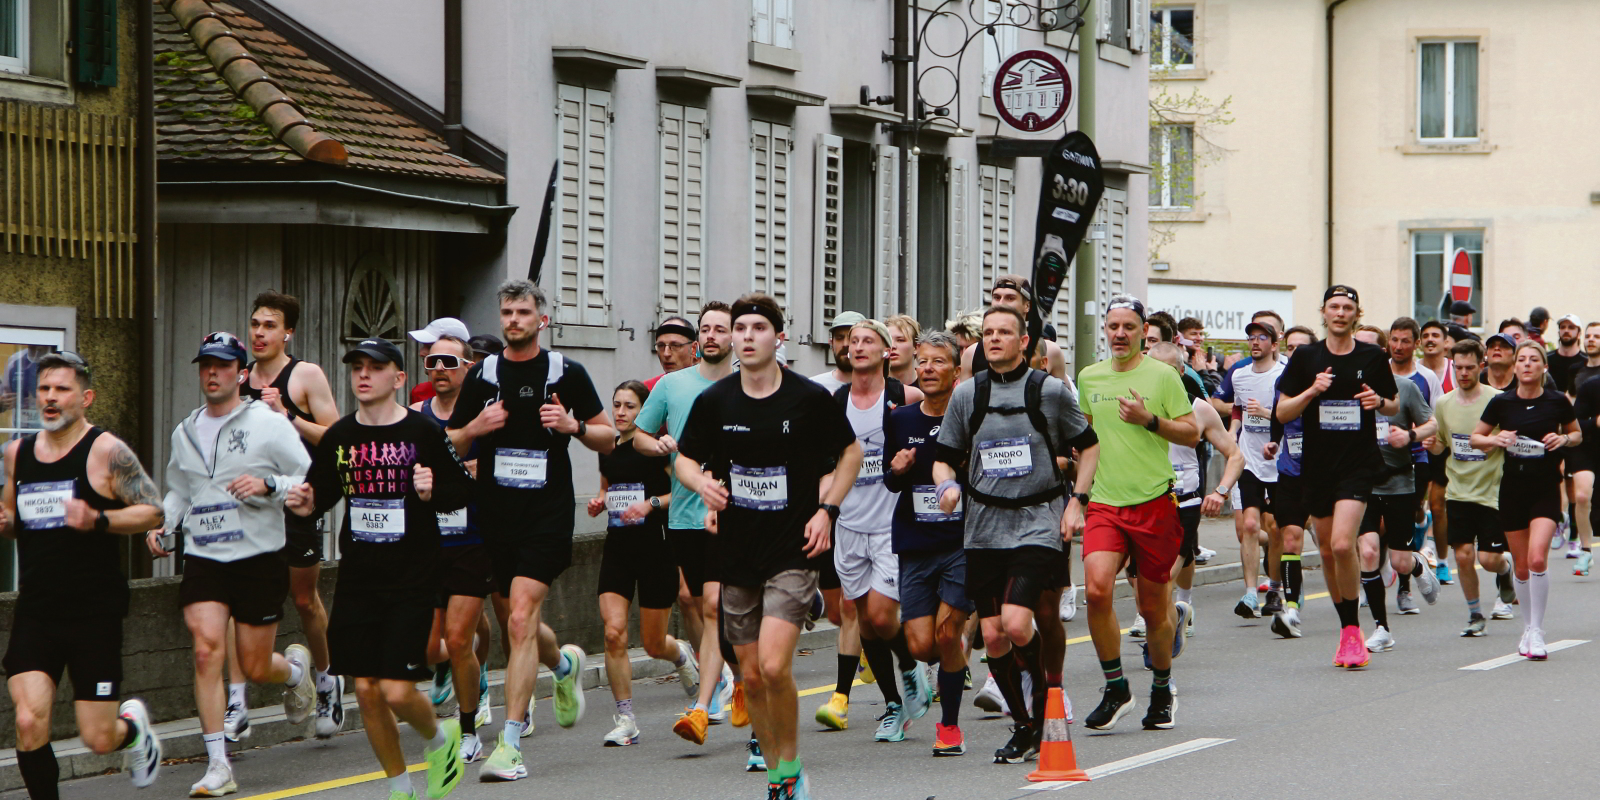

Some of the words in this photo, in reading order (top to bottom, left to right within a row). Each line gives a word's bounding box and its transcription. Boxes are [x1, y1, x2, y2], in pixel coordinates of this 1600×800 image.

[1053, 173, 1089, 207] 3:30
[987, 449, 1023, 460] SANDRO
[510, 468, 528, 476] 1380
[738, 479, 778, 491] JULIAN
[608, 494, 638, 502] FEDERICA
[748, 488, 766, 497] 7201
[24, 496, 64, 508] NIKOLAUS
[199, 514, 226, 527] ALEX
[361, 512, 389, 523] ALEX
[366, 521, 384, 529] 6383
